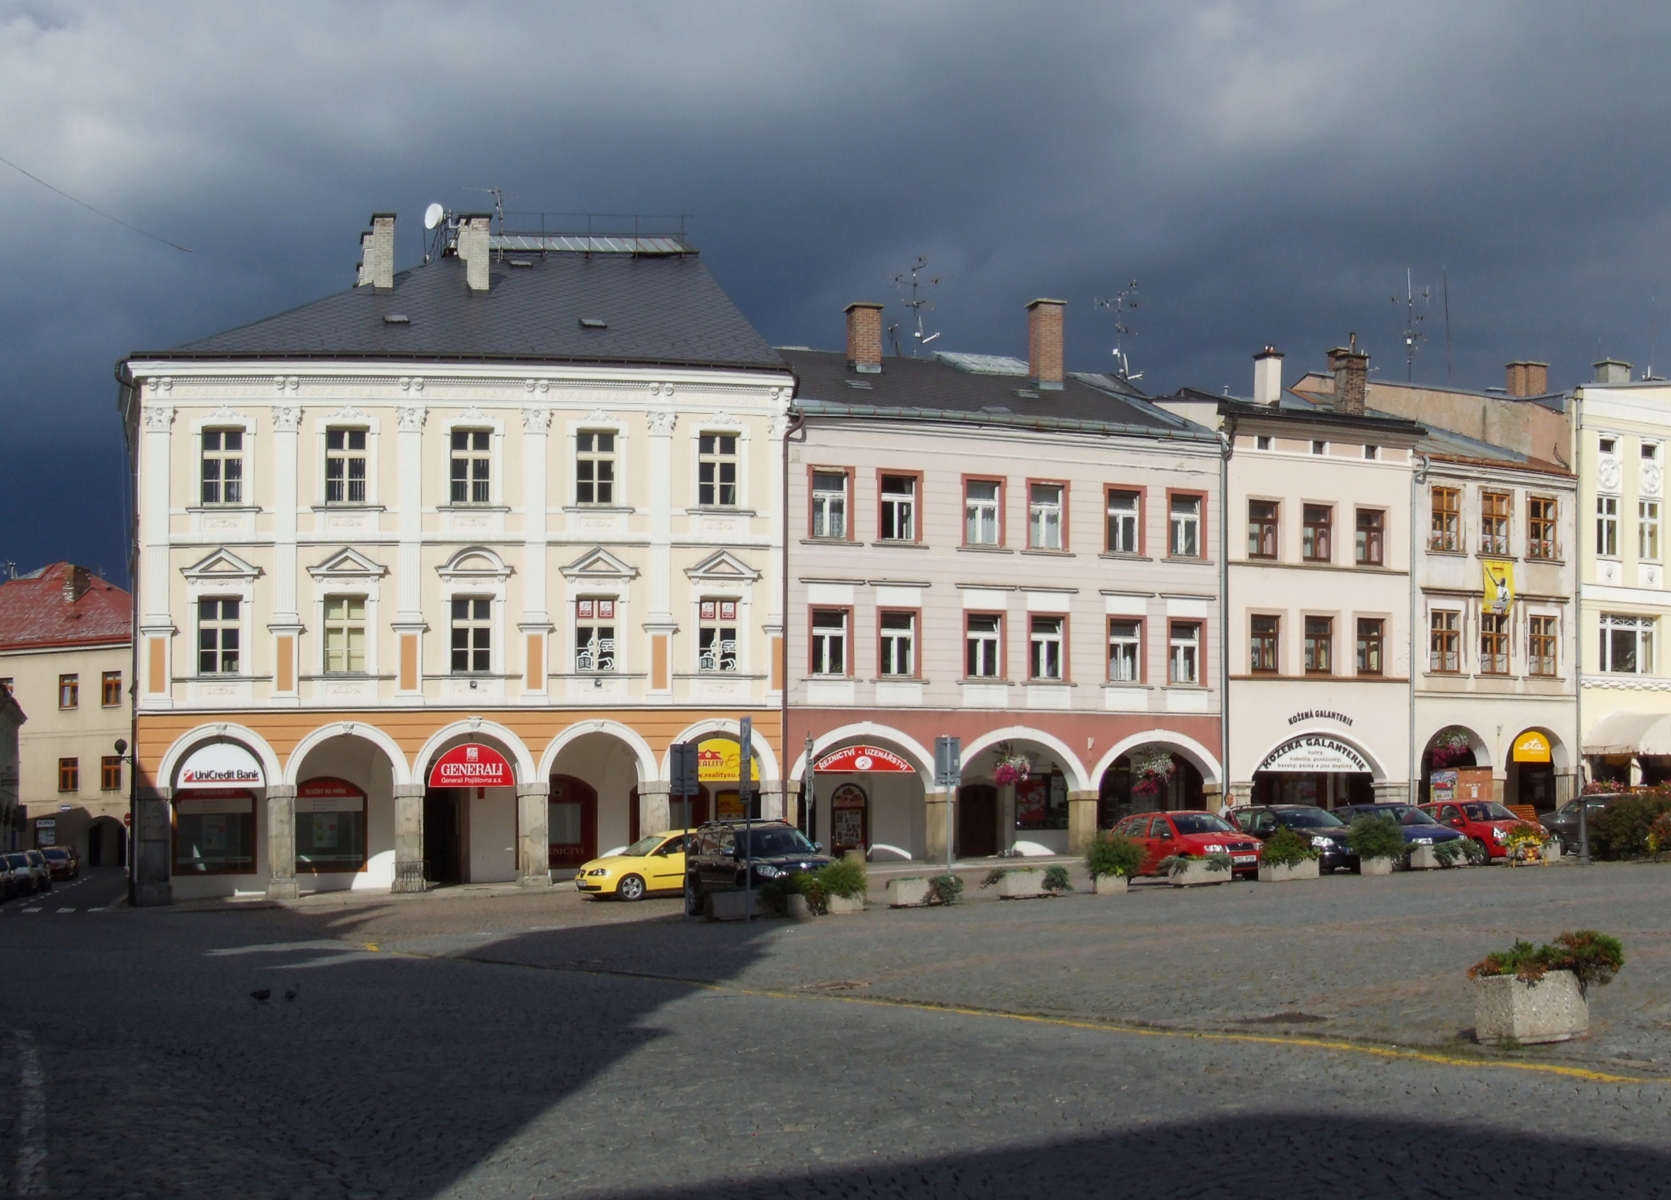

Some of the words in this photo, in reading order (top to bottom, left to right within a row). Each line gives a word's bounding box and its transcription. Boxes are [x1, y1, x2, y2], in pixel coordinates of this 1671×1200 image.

[1315, 710, 1353, 726] GALANTERIE
[1518, 738, 1546, 750] eta
[1306, 738, 1367, 771] GALANTERIE
[194, 770, 235, 780] UniCredit
[236, 769, 259, 779] Bank
[441, 763, 503, 776] GENERALI
